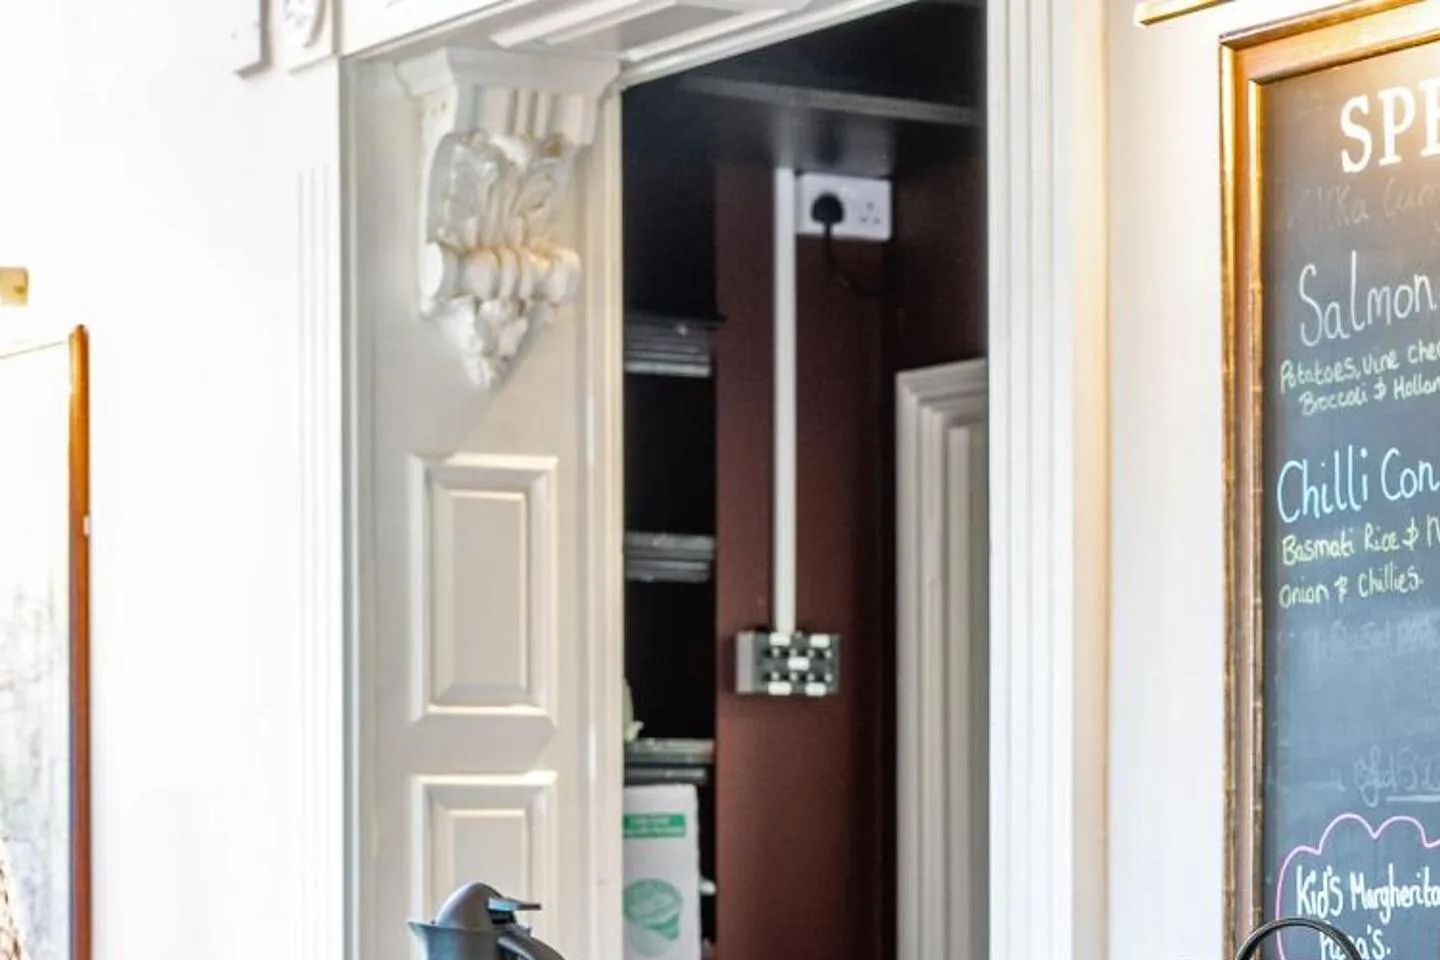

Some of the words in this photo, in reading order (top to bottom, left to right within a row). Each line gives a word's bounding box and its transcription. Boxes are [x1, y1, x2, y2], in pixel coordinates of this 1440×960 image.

[1298, 386, 1368, 416] Broccoli
[1277, 444, 1369, 523] Chilli
[1381, 447, 1440, 501] Con
[1282, 527, 1356, 566] Basmati
[1364, 522, 1400, 553] Rice
